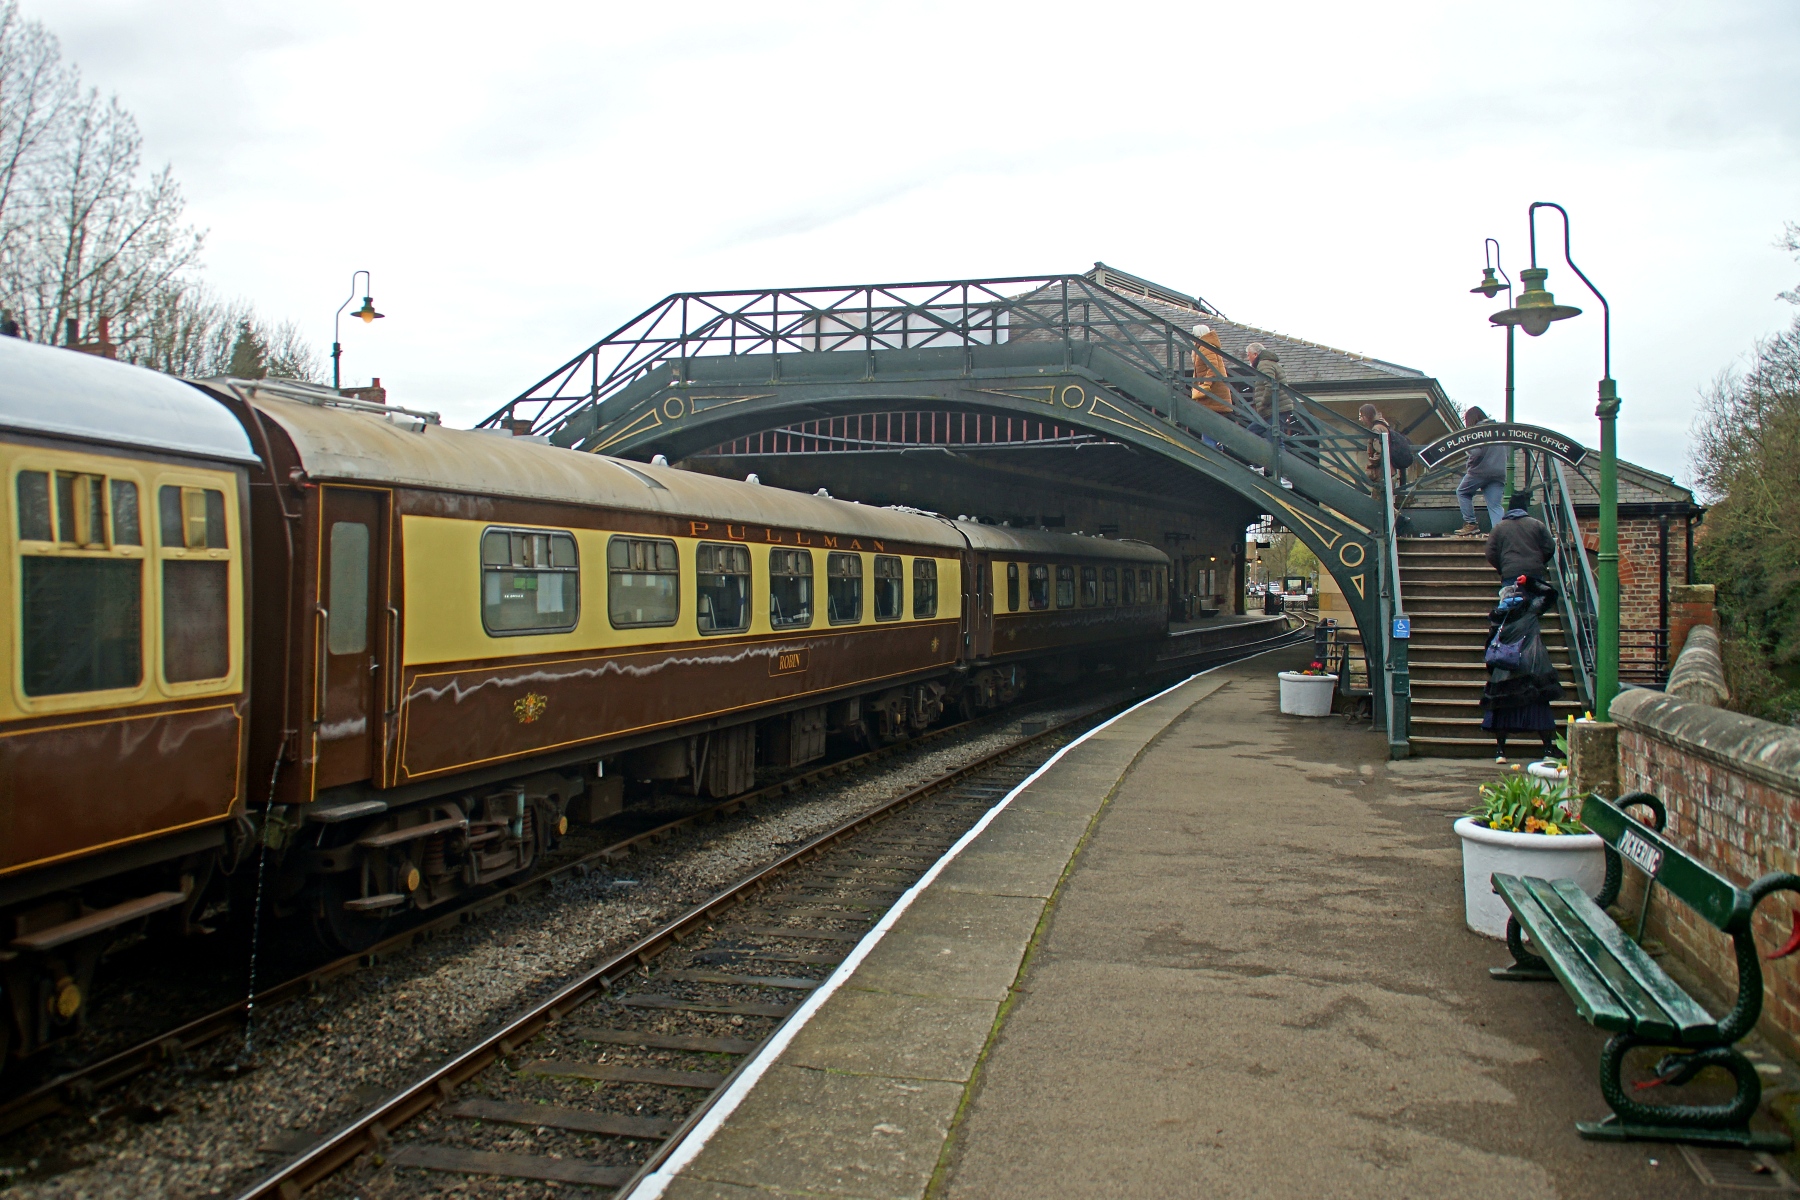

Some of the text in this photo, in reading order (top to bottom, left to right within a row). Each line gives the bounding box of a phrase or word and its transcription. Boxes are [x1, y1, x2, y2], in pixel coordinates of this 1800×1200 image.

[1446, 430, 1492, 449] PLATFORM
[1495, 430, 1499, 438] 1
[1508, 429, 1538, 440] TICKET
[1540, 435, 1570, 454] OFFICE
[688, 521, 885, 553] PULLMAN
[779, 653, 801, 670] ROBIN
[1619, 829, 1660, 873] PICKERING
